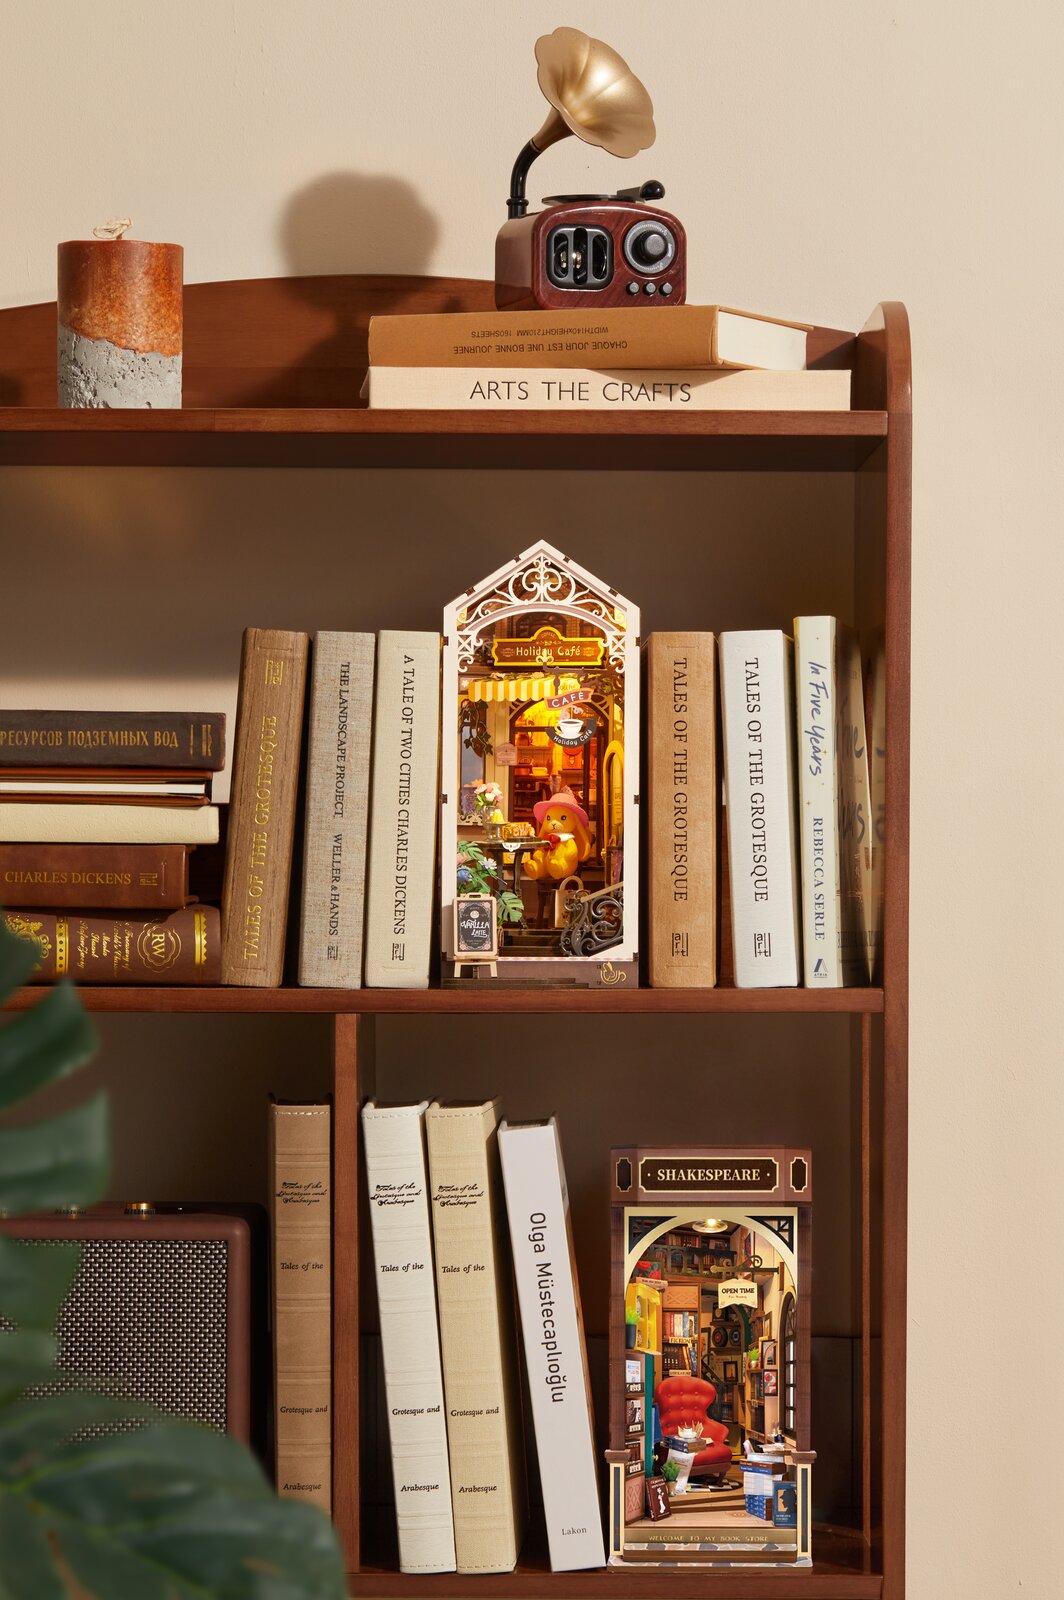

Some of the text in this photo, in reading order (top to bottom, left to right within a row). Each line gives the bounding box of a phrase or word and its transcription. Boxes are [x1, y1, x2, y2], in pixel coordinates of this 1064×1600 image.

[453, 340, 627, 355] CHAQUE JOUR EST UNE BONNE JOURNEE
[470, 380, 692, 403] ARTS THE CRAFTS
[557, 646, 581, 657] Café
[339, 662, 350, 686] THE
[336, 689, 349, 763] LANDSCAPE
[800, 661, 830, 777] In Five Years
[68, 731, 149, 748] ПОДЗЕМНЫХ
[154, 731, 179, 748] ВОД
[553, 736, 578, 745] Holiday
[671, 658, 688, 903] TALES OF THE GROTESQUE
[745, 658, 768, 903] TALES OF THE GROTESQUE
[393, 654, 415, 935] A TALE OF TWO CITIES CHARLES DICKENS
[243, 715, 278, 960] TALES OF THE GROTESQUE
[5, 871, 131, 884] CHARLES DICKENS
[813, 817, 825, 941] REBECCA SERLE
[328, 893, 340, 936] HANDS
[153, 933, 166, 959] RW
[657, 1169, 760, 1181] SHAKESPEARE
[280, 1262, 324, 1272] Tales of the
[381, 1262, 424, 1274] Tales of the
[442, 1264, 485, 1275] Tales of the
[527, 1211, 567, 1403] Olga Müstecaplıoğlu
[280, 1405, 328, 1417] Grotesque and
[392, 1405, 440, 1418] Grotesque and
[451, 1407, 499, 1418] Grotesque and
[283, 1482, 322, 1493] Arabesque
[401, 1483, 439, 1493] Arabesque
[459, 1484, 497, 1495] Arabesque
[561, 1526, 587, 1536] Lakon
